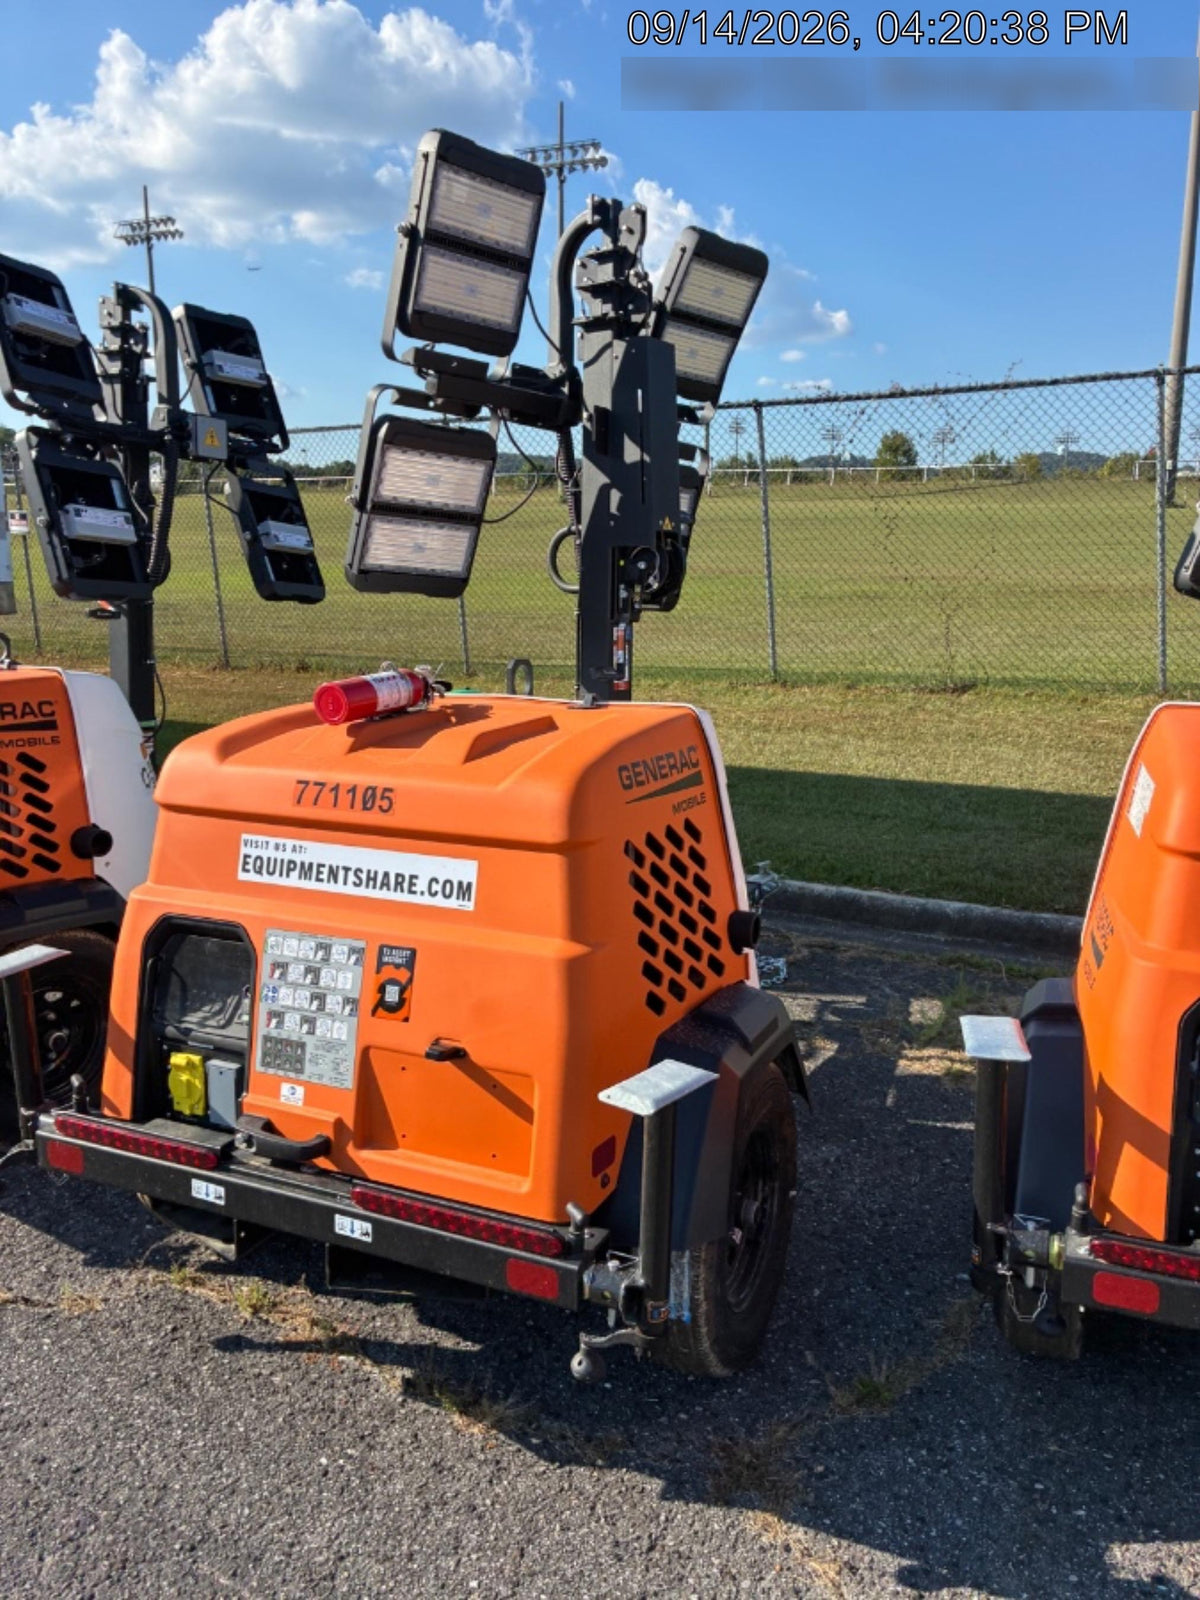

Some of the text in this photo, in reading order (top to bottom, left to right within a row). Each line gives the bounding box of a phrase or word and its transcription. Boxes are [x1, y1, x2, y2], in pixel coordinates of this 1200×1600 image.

[0, 735, 61, 749] MOBILE
[618, 745, 700, 791] GENERAC
[295, 780, 395, 813] 771105
[672, 792, 707, 815] MOBILE
[243, 838, 308, 854] VISIT US AT:
[241, 853, 473, 902] EQUIPMENTSHARE.COM
